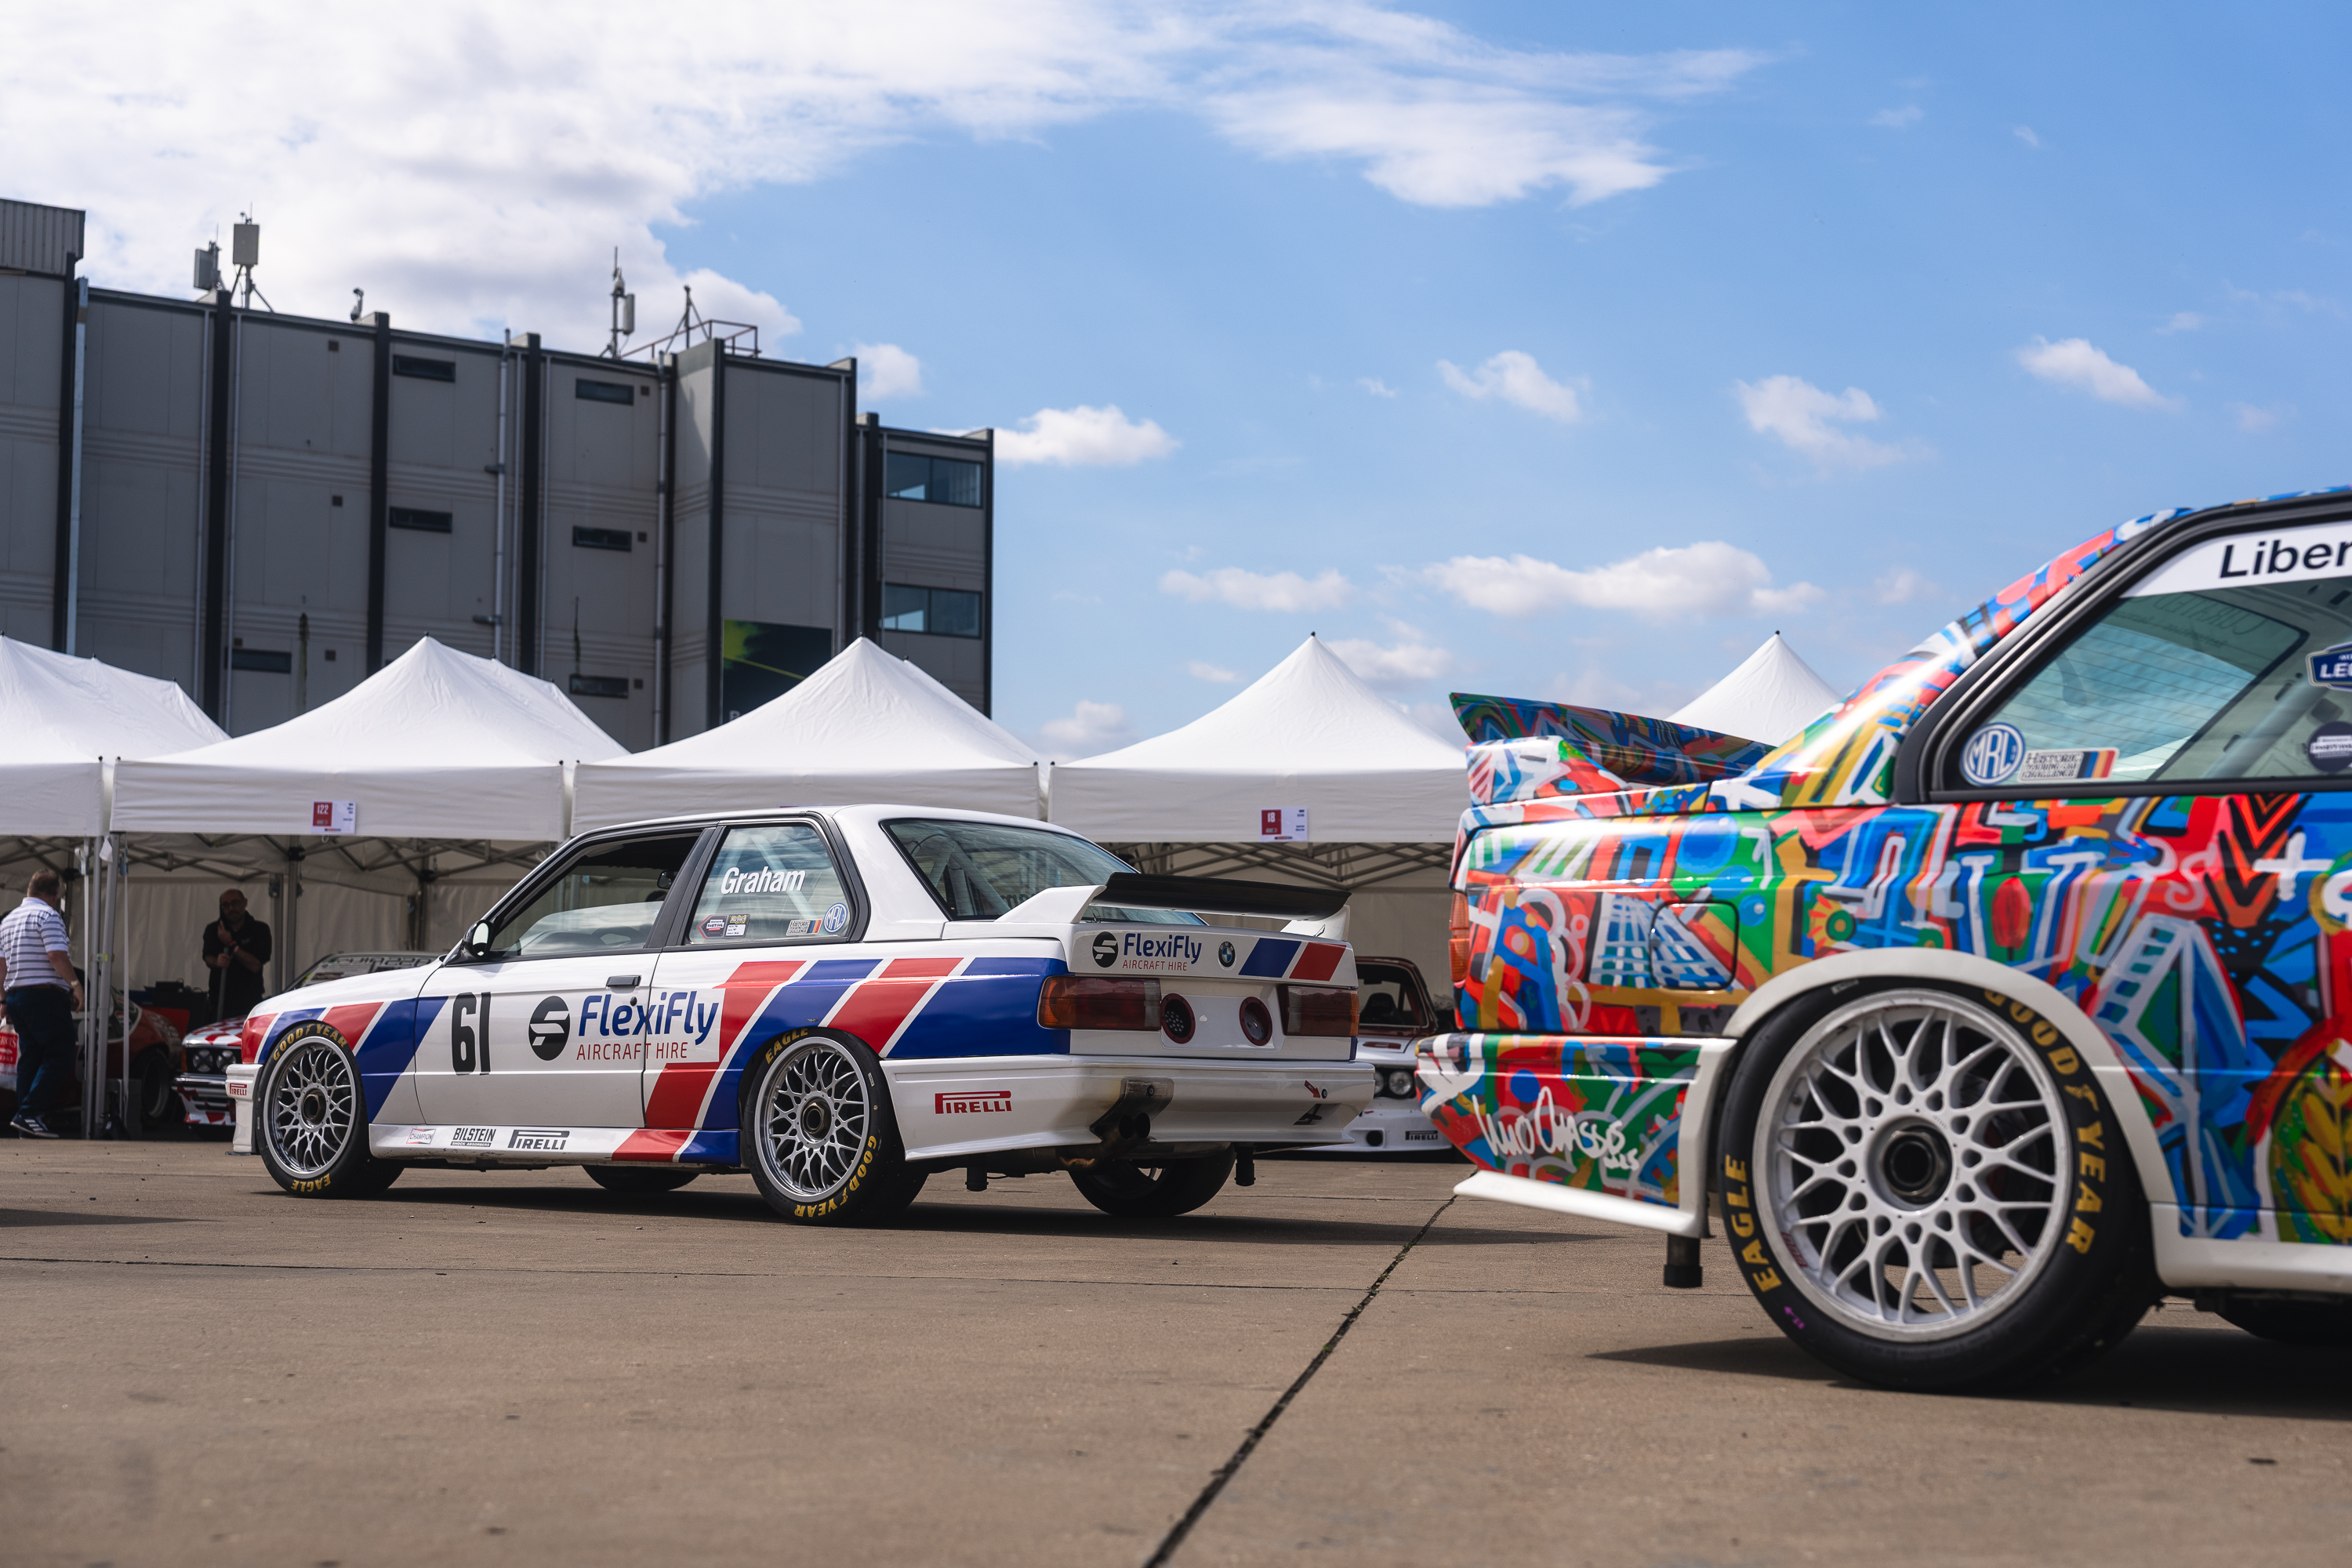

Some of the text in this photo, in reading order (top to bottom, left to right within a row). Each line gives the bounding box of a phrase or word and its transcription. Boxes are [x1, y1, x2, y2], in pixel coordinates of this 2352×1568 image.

[2220, 539, 2352, 579] Liber
[2319, 662, 2352, 679] LE
[1969, 730, 2012, 779] MRL
[317, 804, 329, 815] 122
[1267, 811, 1276, 822] 18
[720, 866, 806, 895] Graham
[826, 906, 843, 931] MRL
[1123, 932, 1202, 965] FlexiFly
[1122, 959, 1188, 971] AIRCRAFT HIRE
[578, 991, 719, 1046] FlexiFly
[273, 1023, 348, 1061] GOOD YEAR
[452, 992, 491, 1076] 61
[764, 1027, 808, 1065] EAGLE
[576, 1042, 688, 1060] AIRCRAFT HIRE
[229, 1083, 248, 1096] PIRELLI
[935, 1090, 1012, 1114] PIRELLI
[452, 1127, 496, 1142] BILSTEIN
[507, 1129, 570, 1150] PIRELLI
[1405, 1130, 1439, 1141] PIRELLI
[290, 1173, 331, 1192] EAGLE
[794, 1135, 877, 1218] GOOD YEAR
[2065, 1121, 2106, 1254] YEAR
[1725, 1154, 1783, 1293] EAGLE
